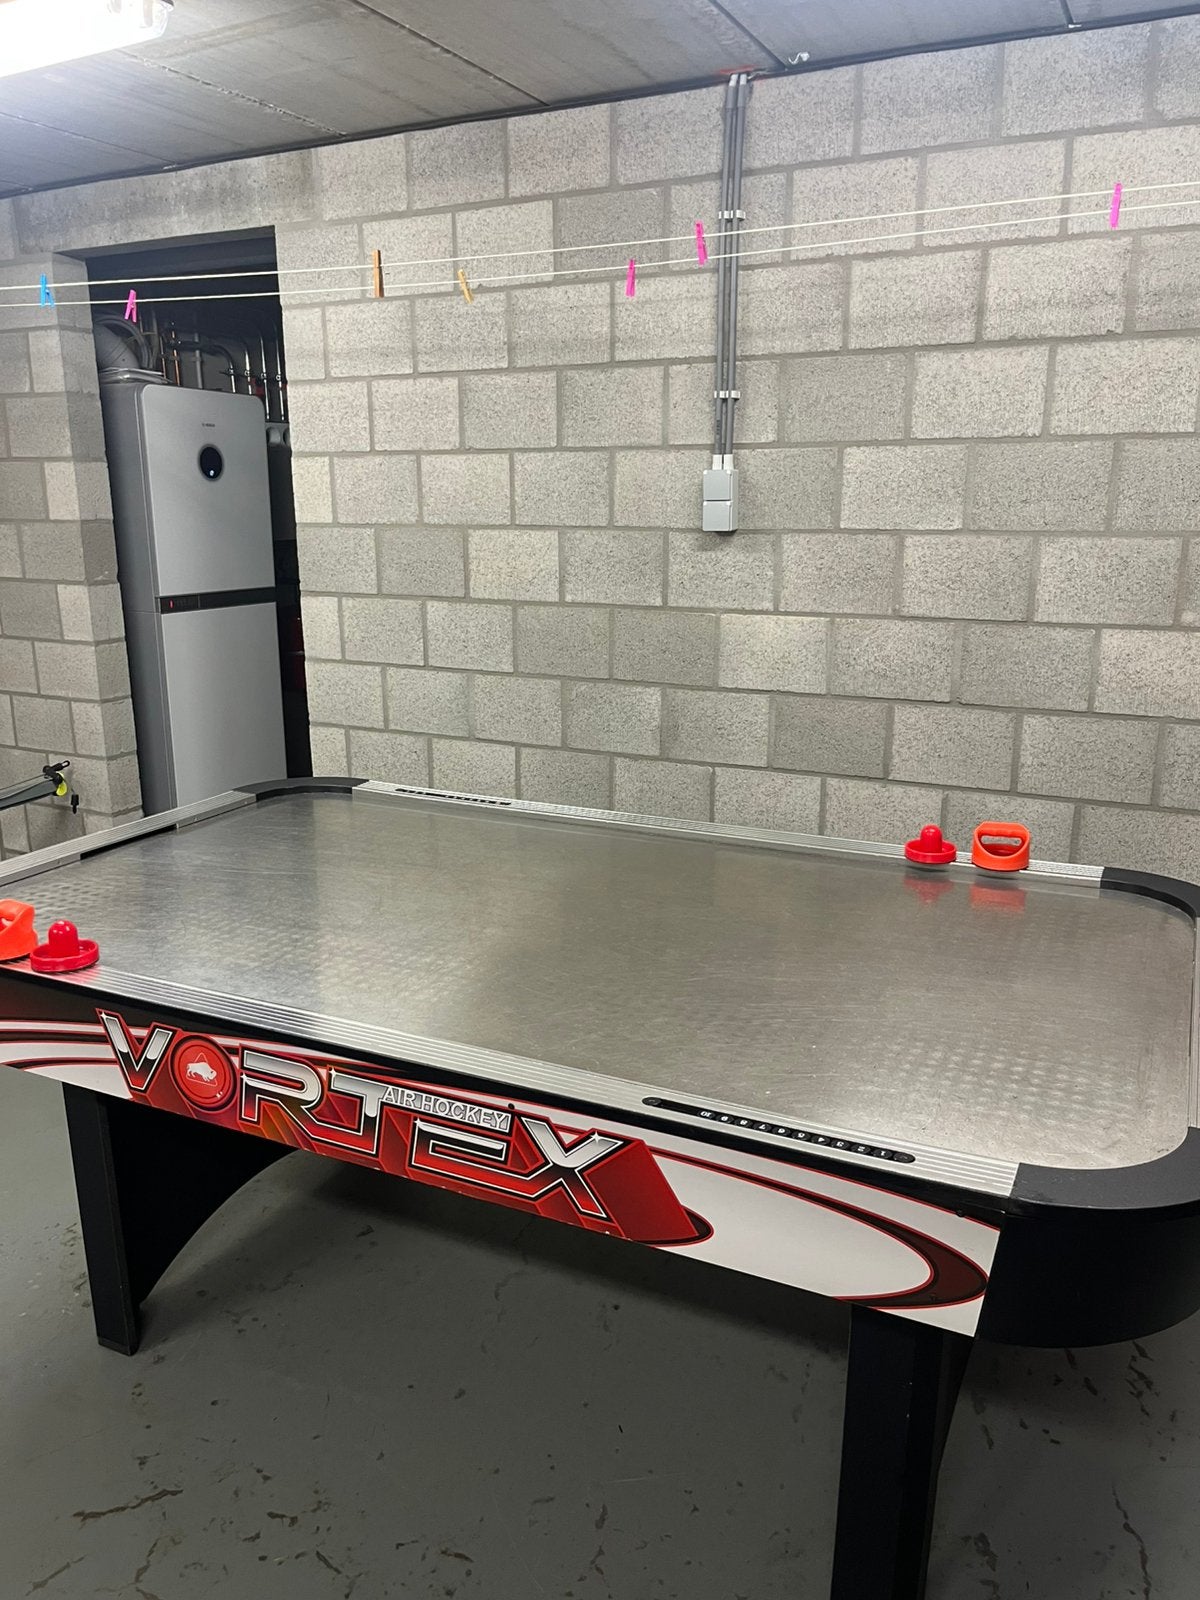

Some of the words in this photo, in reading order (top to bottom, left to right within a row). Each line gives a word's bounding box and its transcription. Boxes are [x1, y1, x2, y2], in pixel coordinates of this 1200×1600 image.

[101, 1011, 626, 1220] VORTEX
[382, 1085, 418, 1110] AIR
[420, 1091, 511, 1132] HOCKEY
